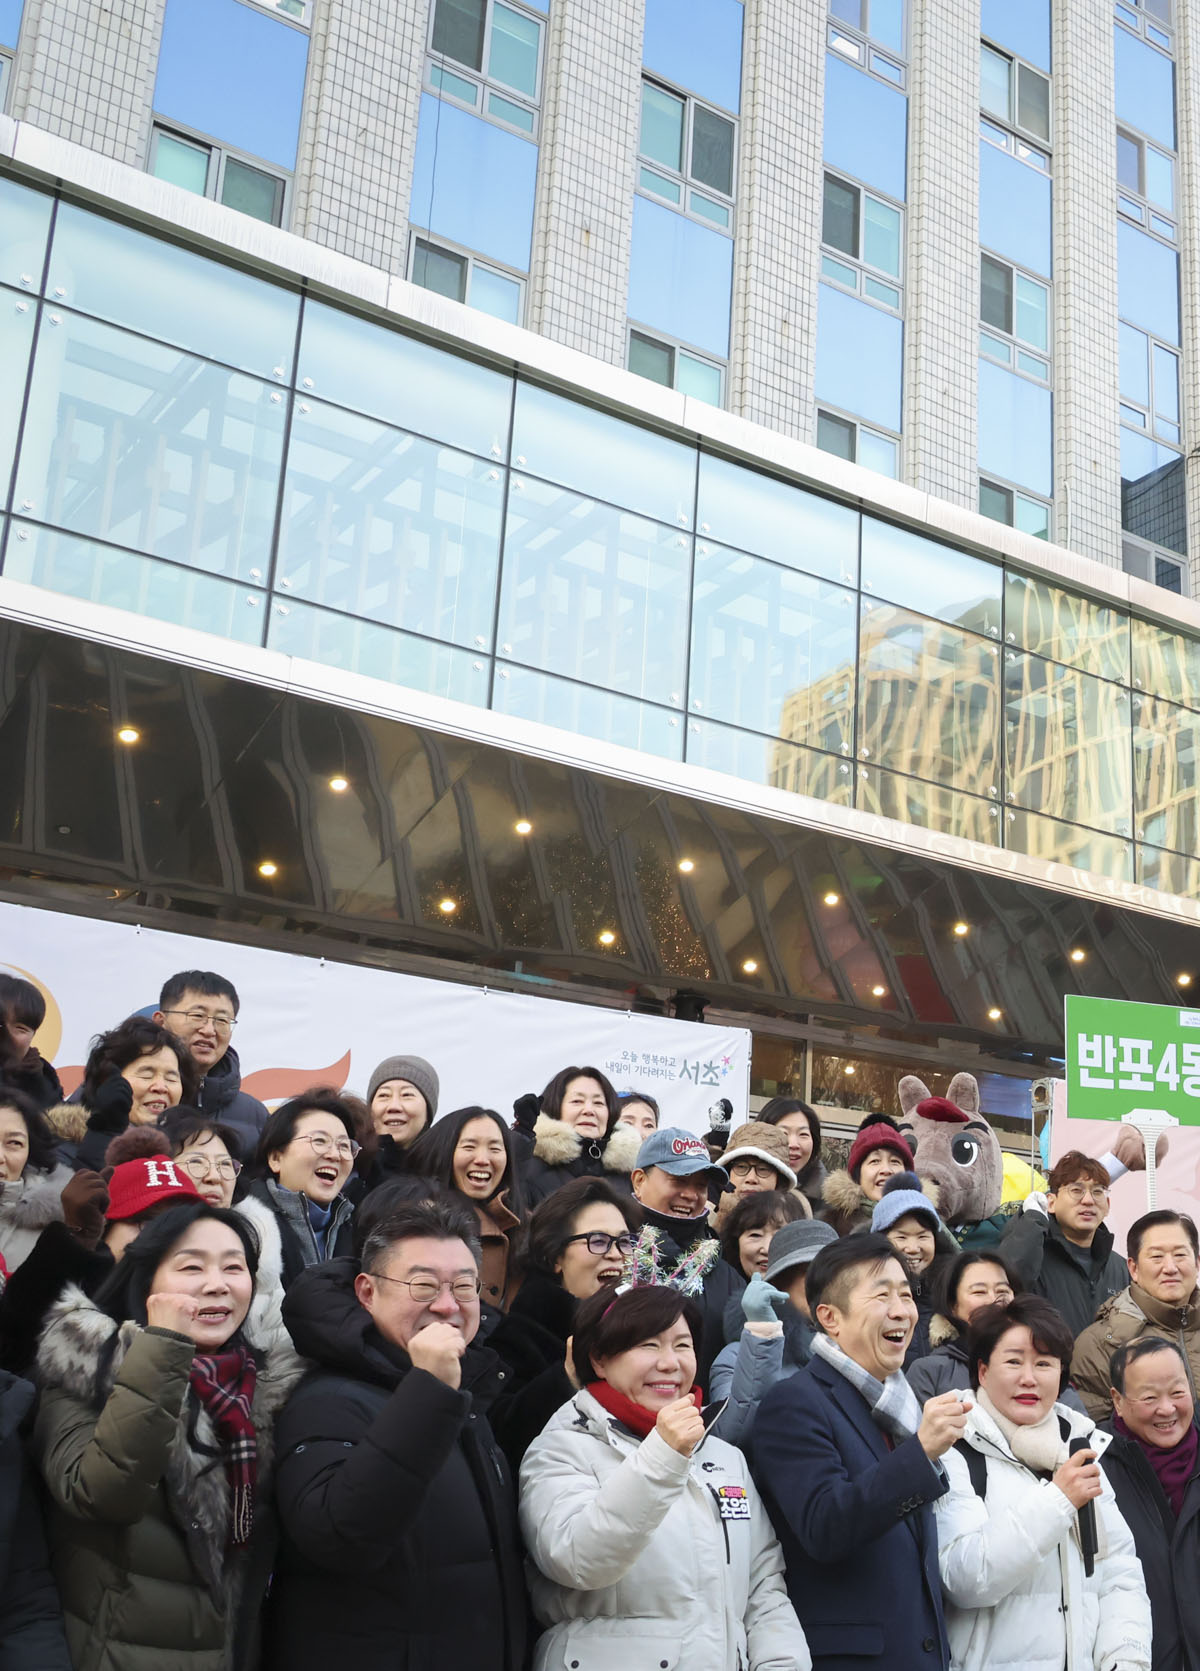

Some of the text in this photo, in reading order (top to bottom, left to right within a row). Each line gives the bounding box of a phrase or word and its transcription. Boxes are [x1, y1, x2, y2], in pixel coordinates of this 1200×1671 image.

[605, 1060, 631, 1075] 내일이
[620, 1050, 677, 1067] 오늘 행복하고
[679, 1059, 720, 1086] 서초
[144, 1161, 183, 1187] H
